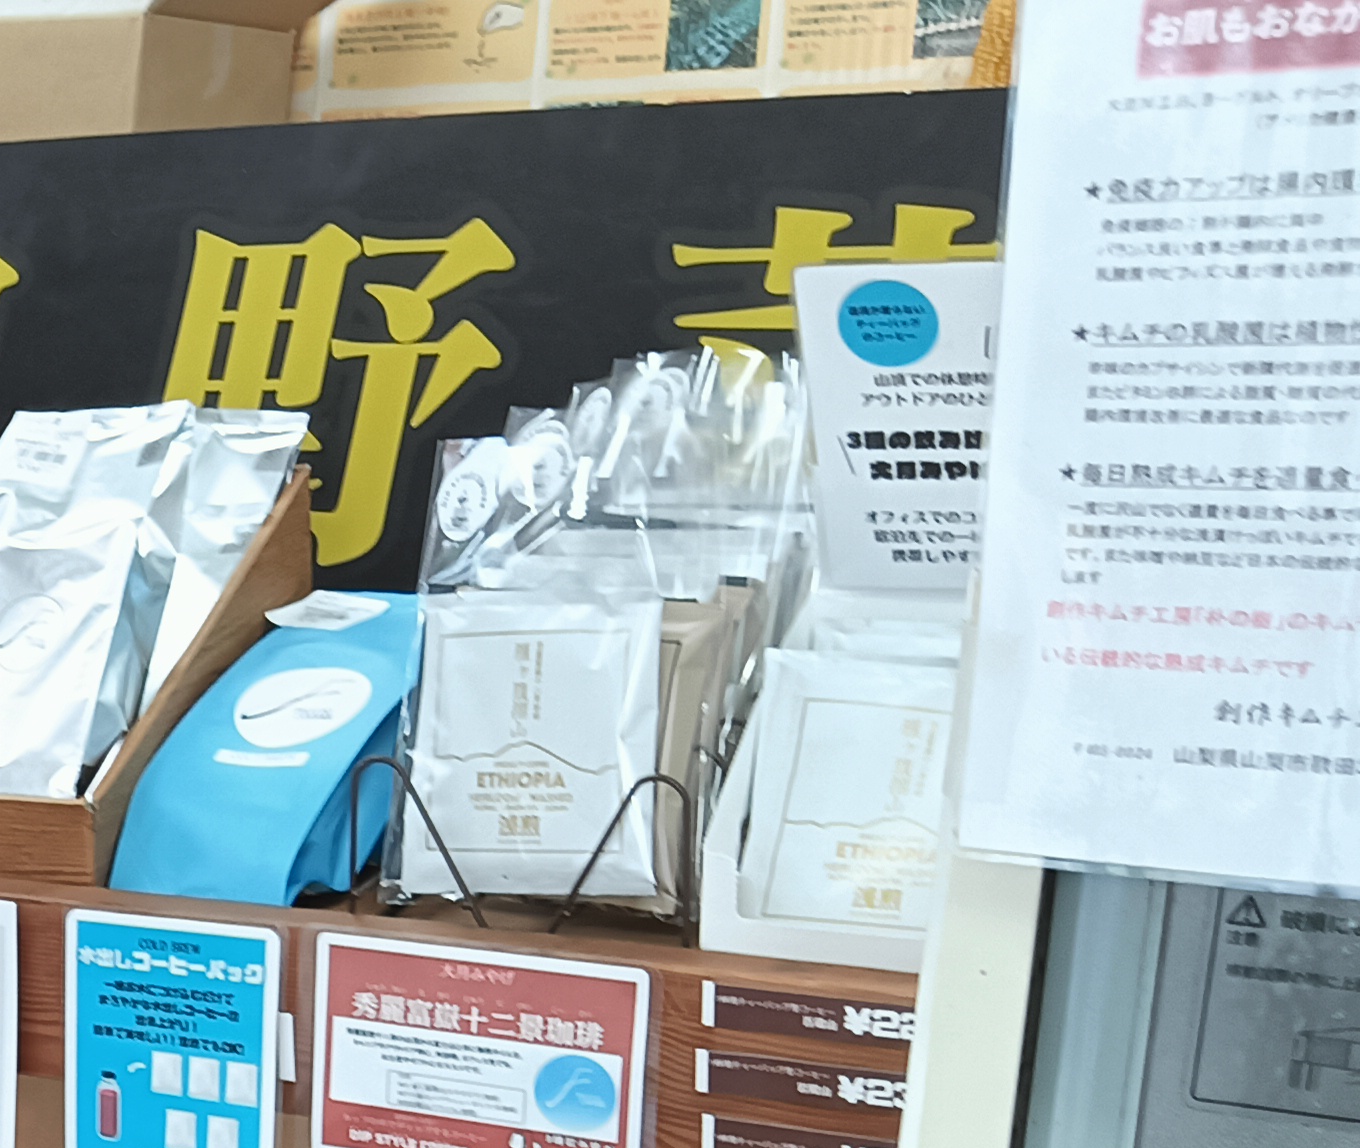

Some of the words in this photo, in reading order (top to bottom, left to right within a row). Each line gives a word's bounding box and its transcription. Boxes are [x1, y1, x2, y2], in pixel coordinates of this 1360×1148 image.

[1214, 700, 1360, 729] 創作キムチ
[476, 771, 566, 789] ETHIOPIA
[78, 945, 264, 985] 水出しコーヒーパック
[351, 991, 605, 1050] 秀麗富嶽十二景珈琲
